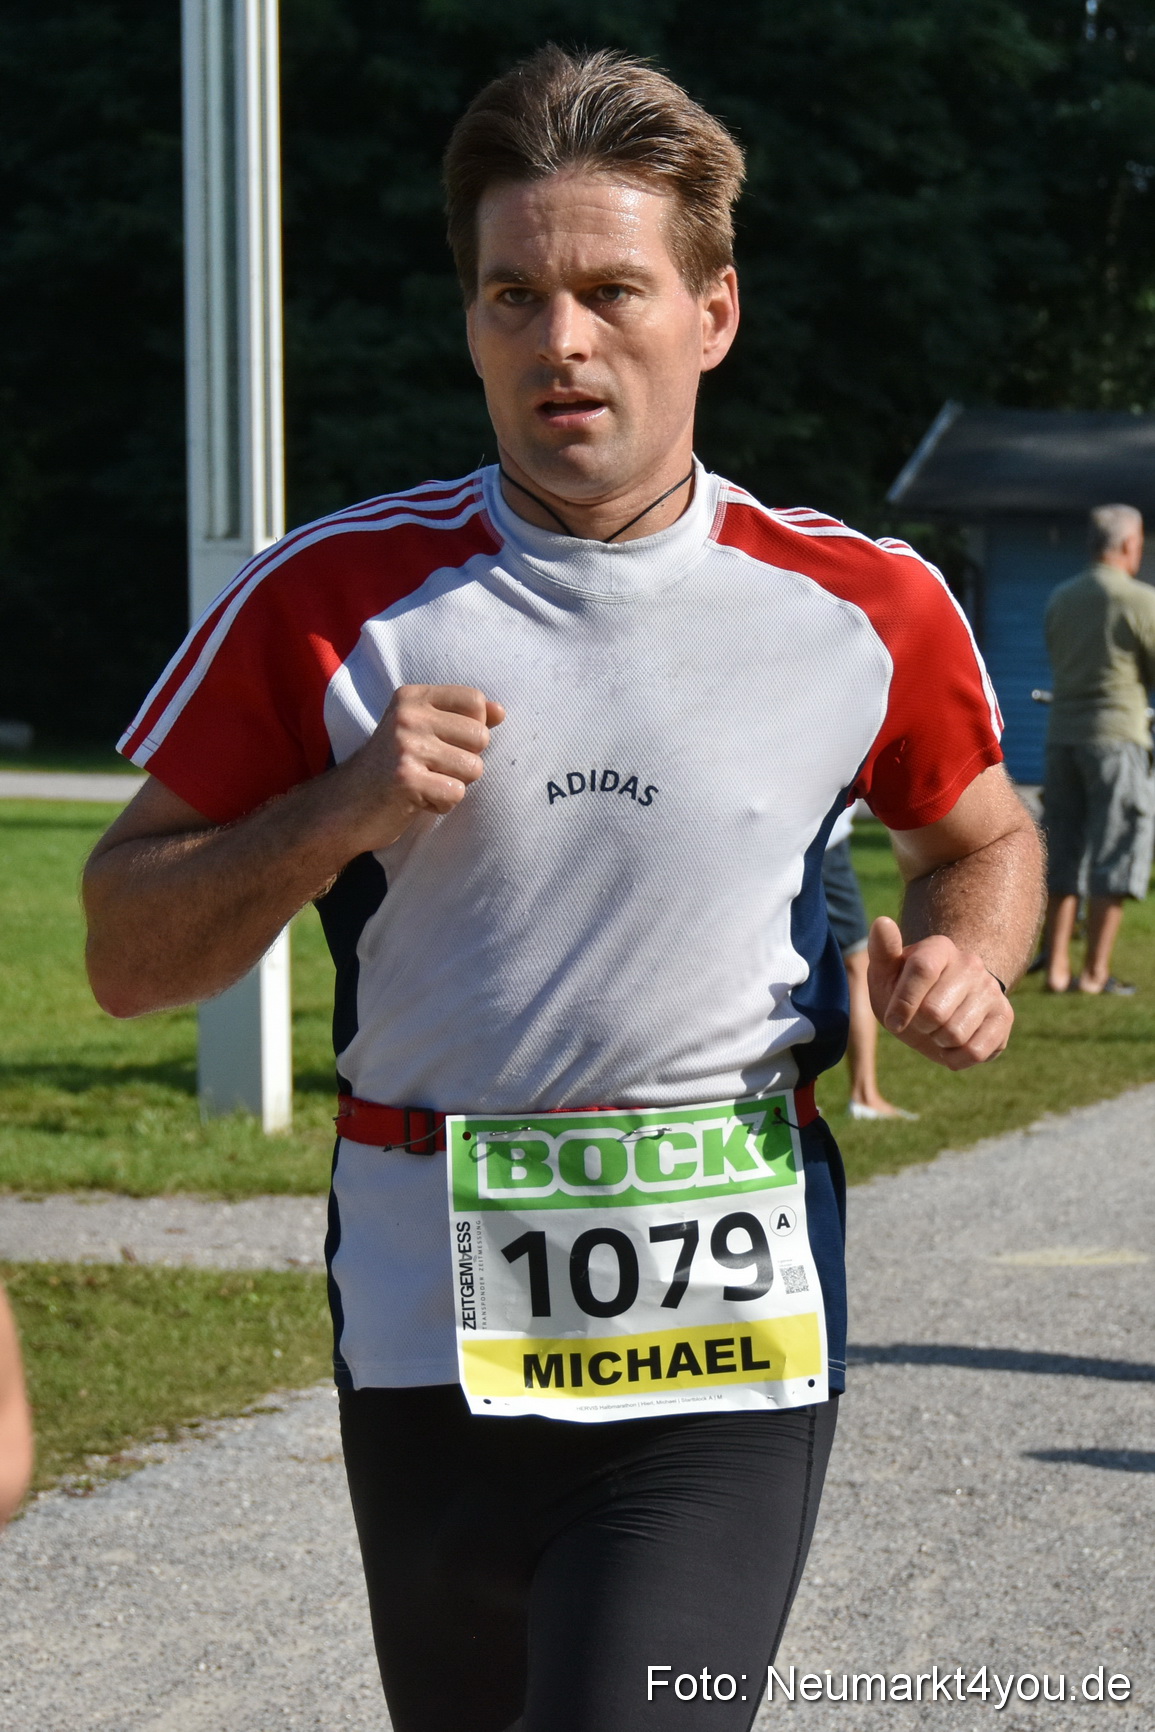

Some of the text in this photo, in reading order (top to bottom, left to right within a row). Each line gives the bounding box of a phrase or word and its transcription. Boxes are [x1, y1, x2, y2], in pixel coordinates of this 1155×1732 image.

[547, 769, 659, 806] ADIDAS
[477, 1117, 776, 1198] BOCK
[776, 1213, 791, 1230] A
[475, 1220, 488, 1330] TRANSPONDER ZEITMESSUNG
[500, 1211, 775, 1319] 1079
[522, 1336, 771, 1389] MICHAEL
